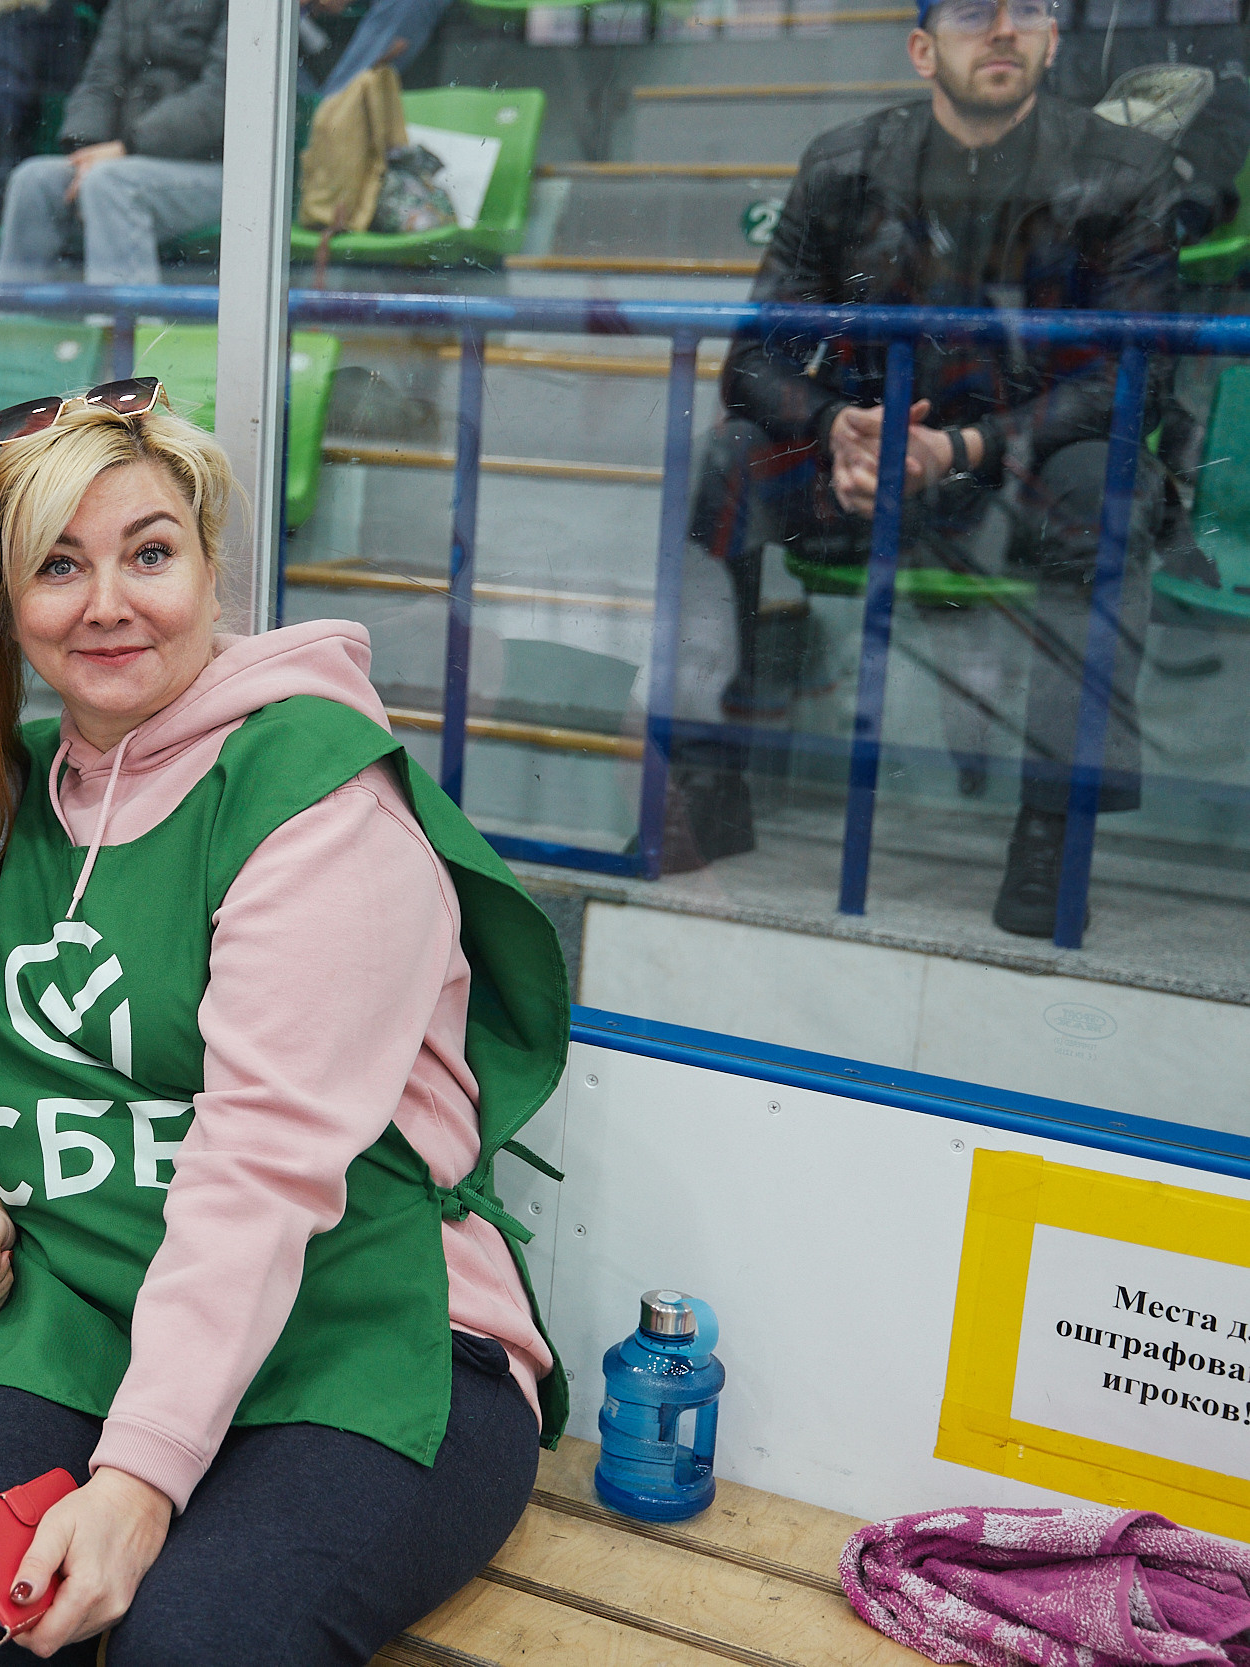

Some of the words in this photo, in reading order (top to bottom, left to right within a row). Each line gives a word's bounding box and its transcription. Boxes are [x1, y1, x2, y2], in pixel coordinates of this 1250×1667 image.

[749, 206, 778, 242] 2
[1113, 1284, 1218, 1333] Места
[1227, 1319, 1250, 1343] д
[1055, 1319, 1250, 1384] оштрафова
[1101, 1371, 1250, 1426] игроков!
